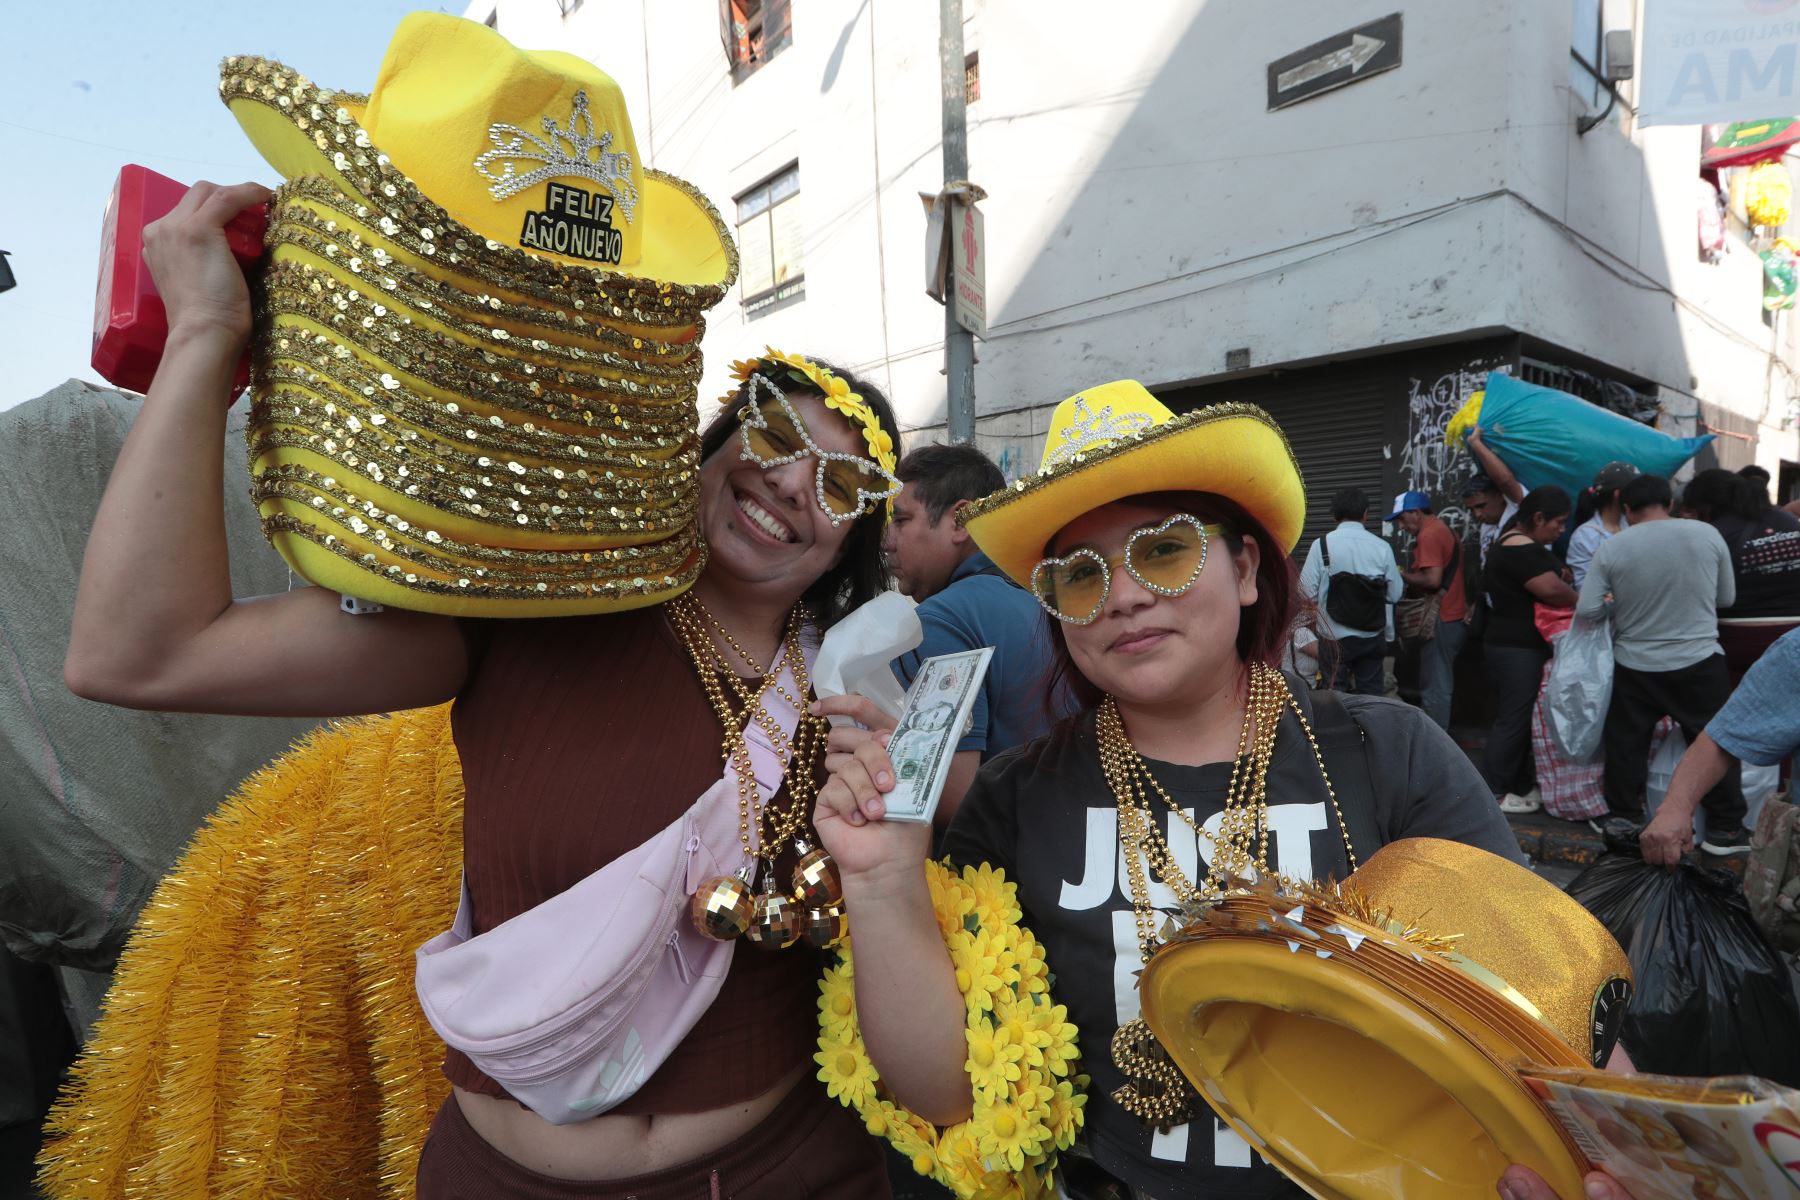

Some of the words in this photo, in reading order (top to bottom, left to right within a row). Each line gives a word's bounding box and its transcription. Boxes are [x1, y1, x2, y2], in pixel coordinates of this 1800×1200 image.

[550, 185, 613, 223] FELIZ
[523, 214, 569, 252] AÑO
[570, 223, 621, 262] NUEVO
[957, 279, 983, 312] HIDRANTE
[1058, 801, 1328, 911] JUST
